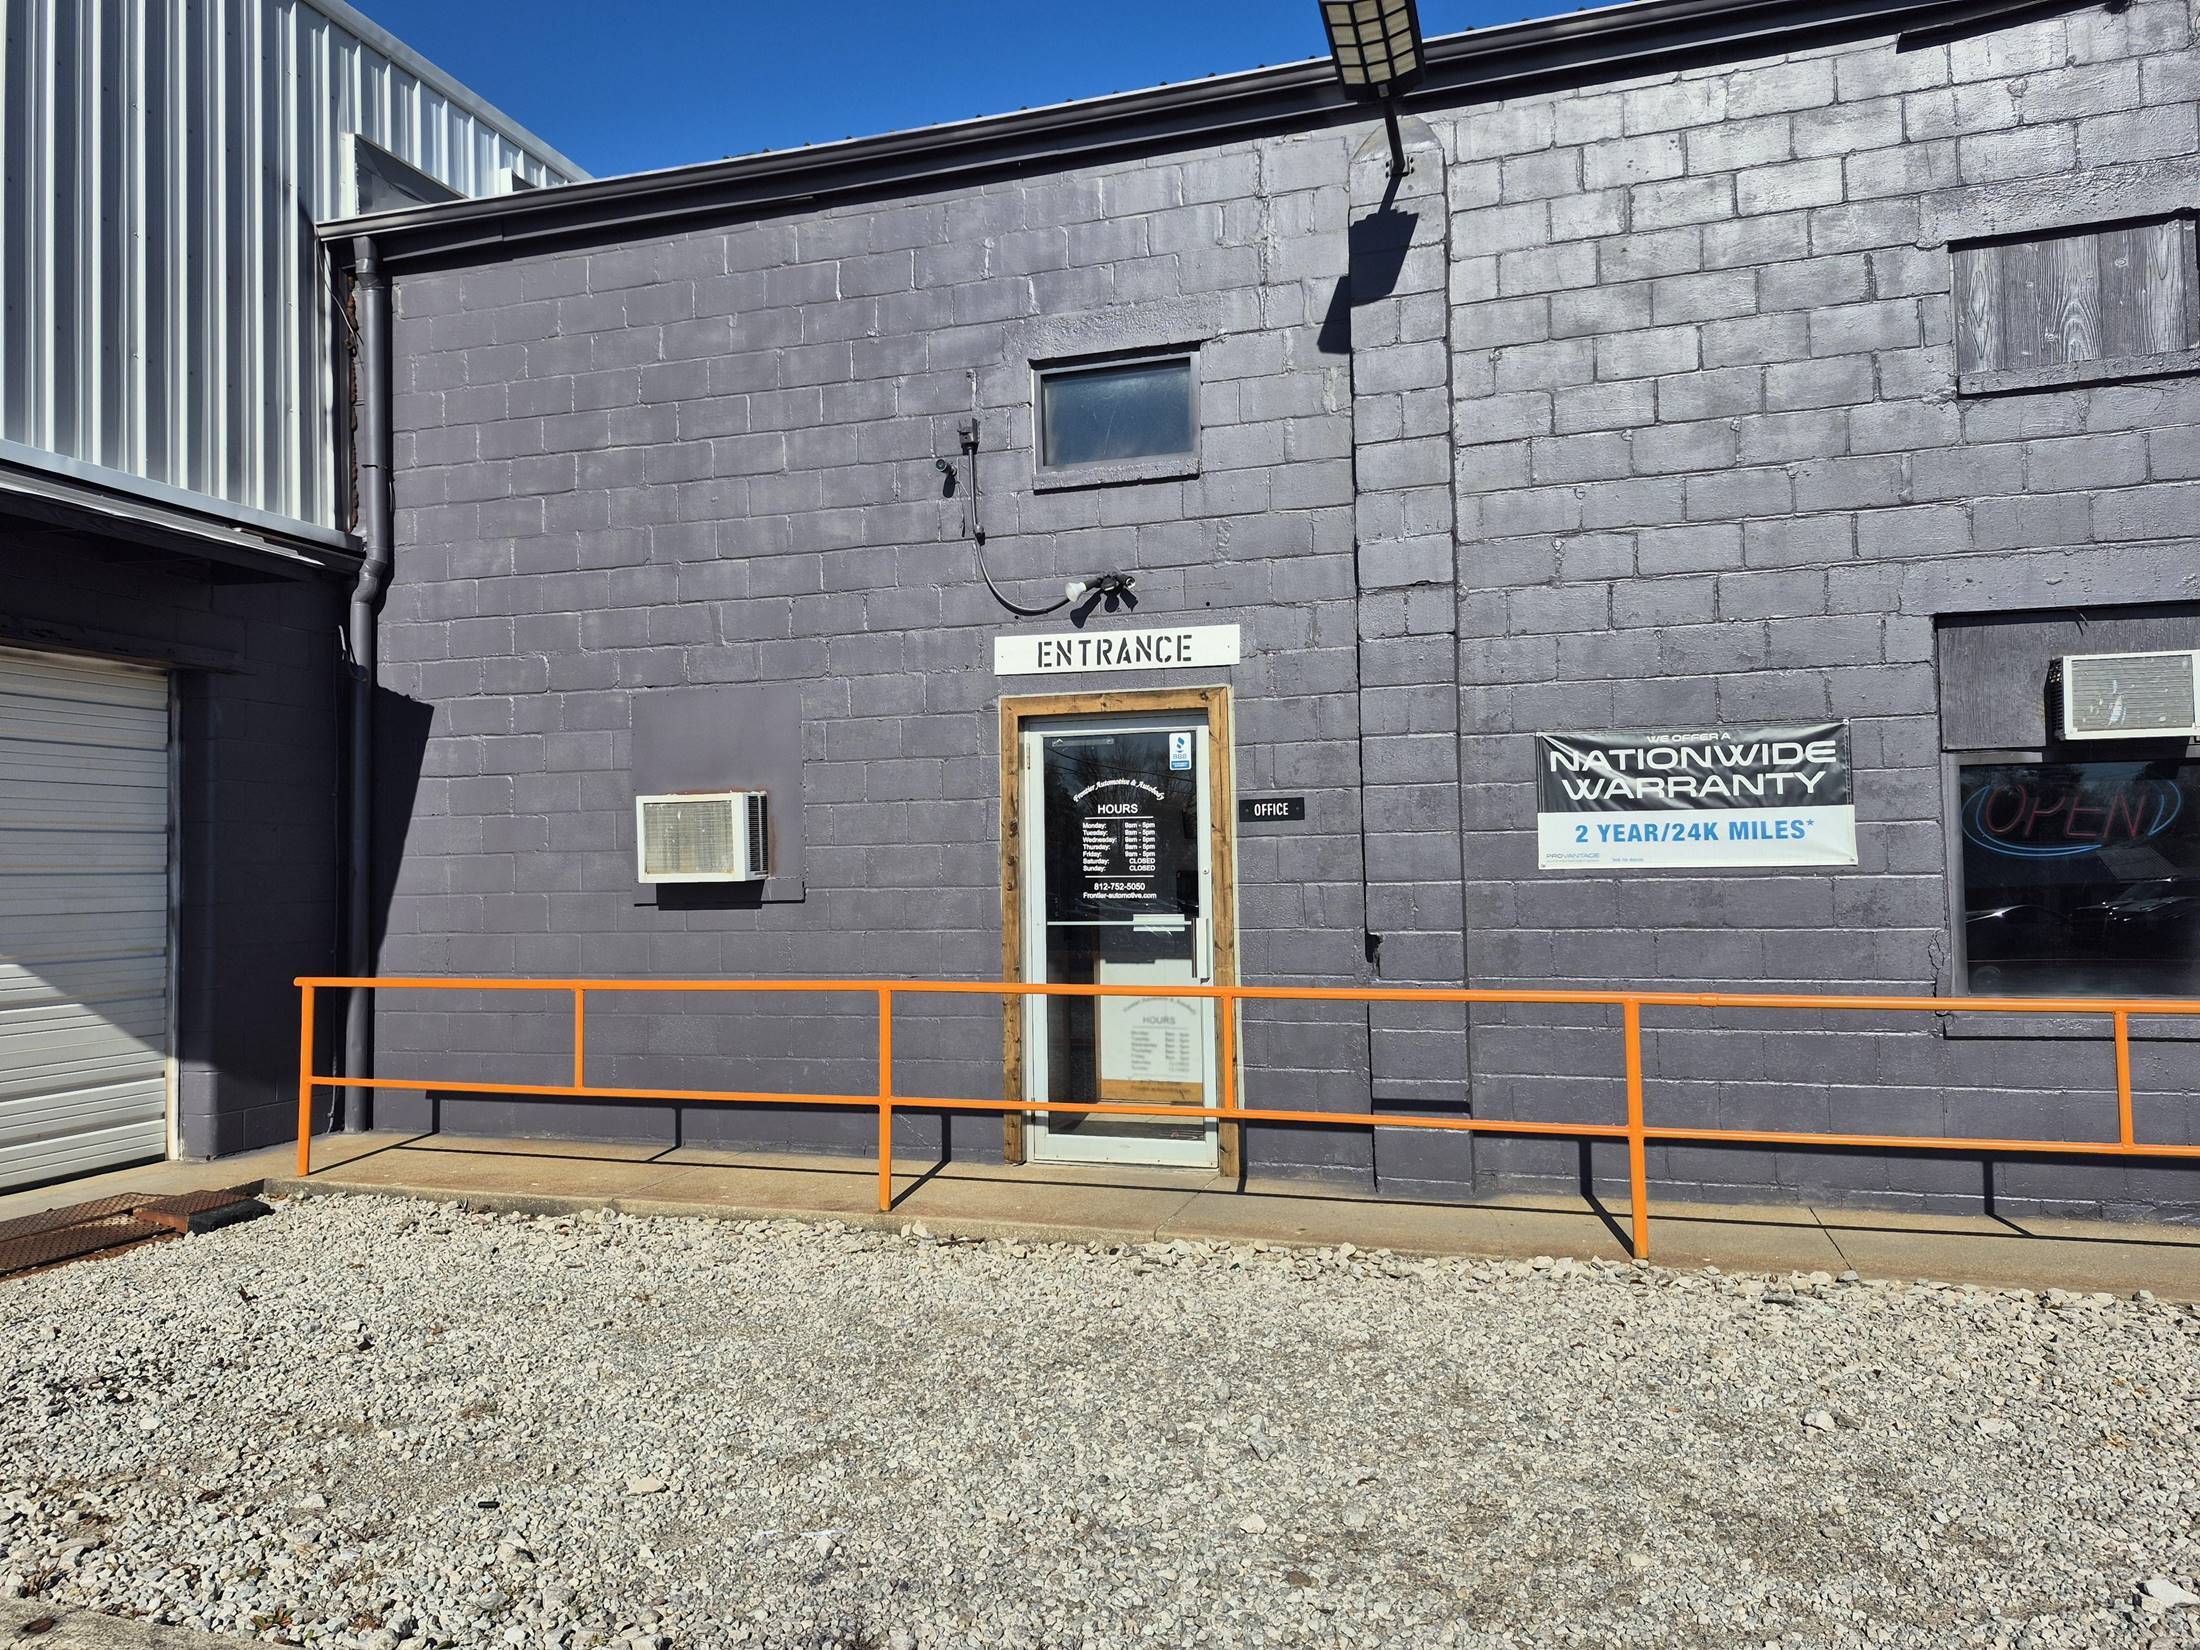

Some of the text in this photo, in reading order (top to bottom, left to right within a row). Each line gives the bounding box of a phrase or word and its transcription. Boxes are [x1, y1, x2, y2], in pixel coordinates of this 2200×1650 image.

[1037, 634, 1193, 668] ENTRANCE
[1646, 731, 1731, 743] WE OFFER A
[1550, 740, 1837, 772] NATIONWIDE
[1561, 771, 1826, 801] WARRANTY
[1097, 803, 1139, 814] HOURS
[1253, 802, 1289, 817] OFFICE
[1985, 784, 2145, 838] OPEN
[1575, 825, 1589, 843] 2
[1597, 821, 1719, 843] YEAR/24K
[1093, 882, 1146, 891] 812-752-5050
